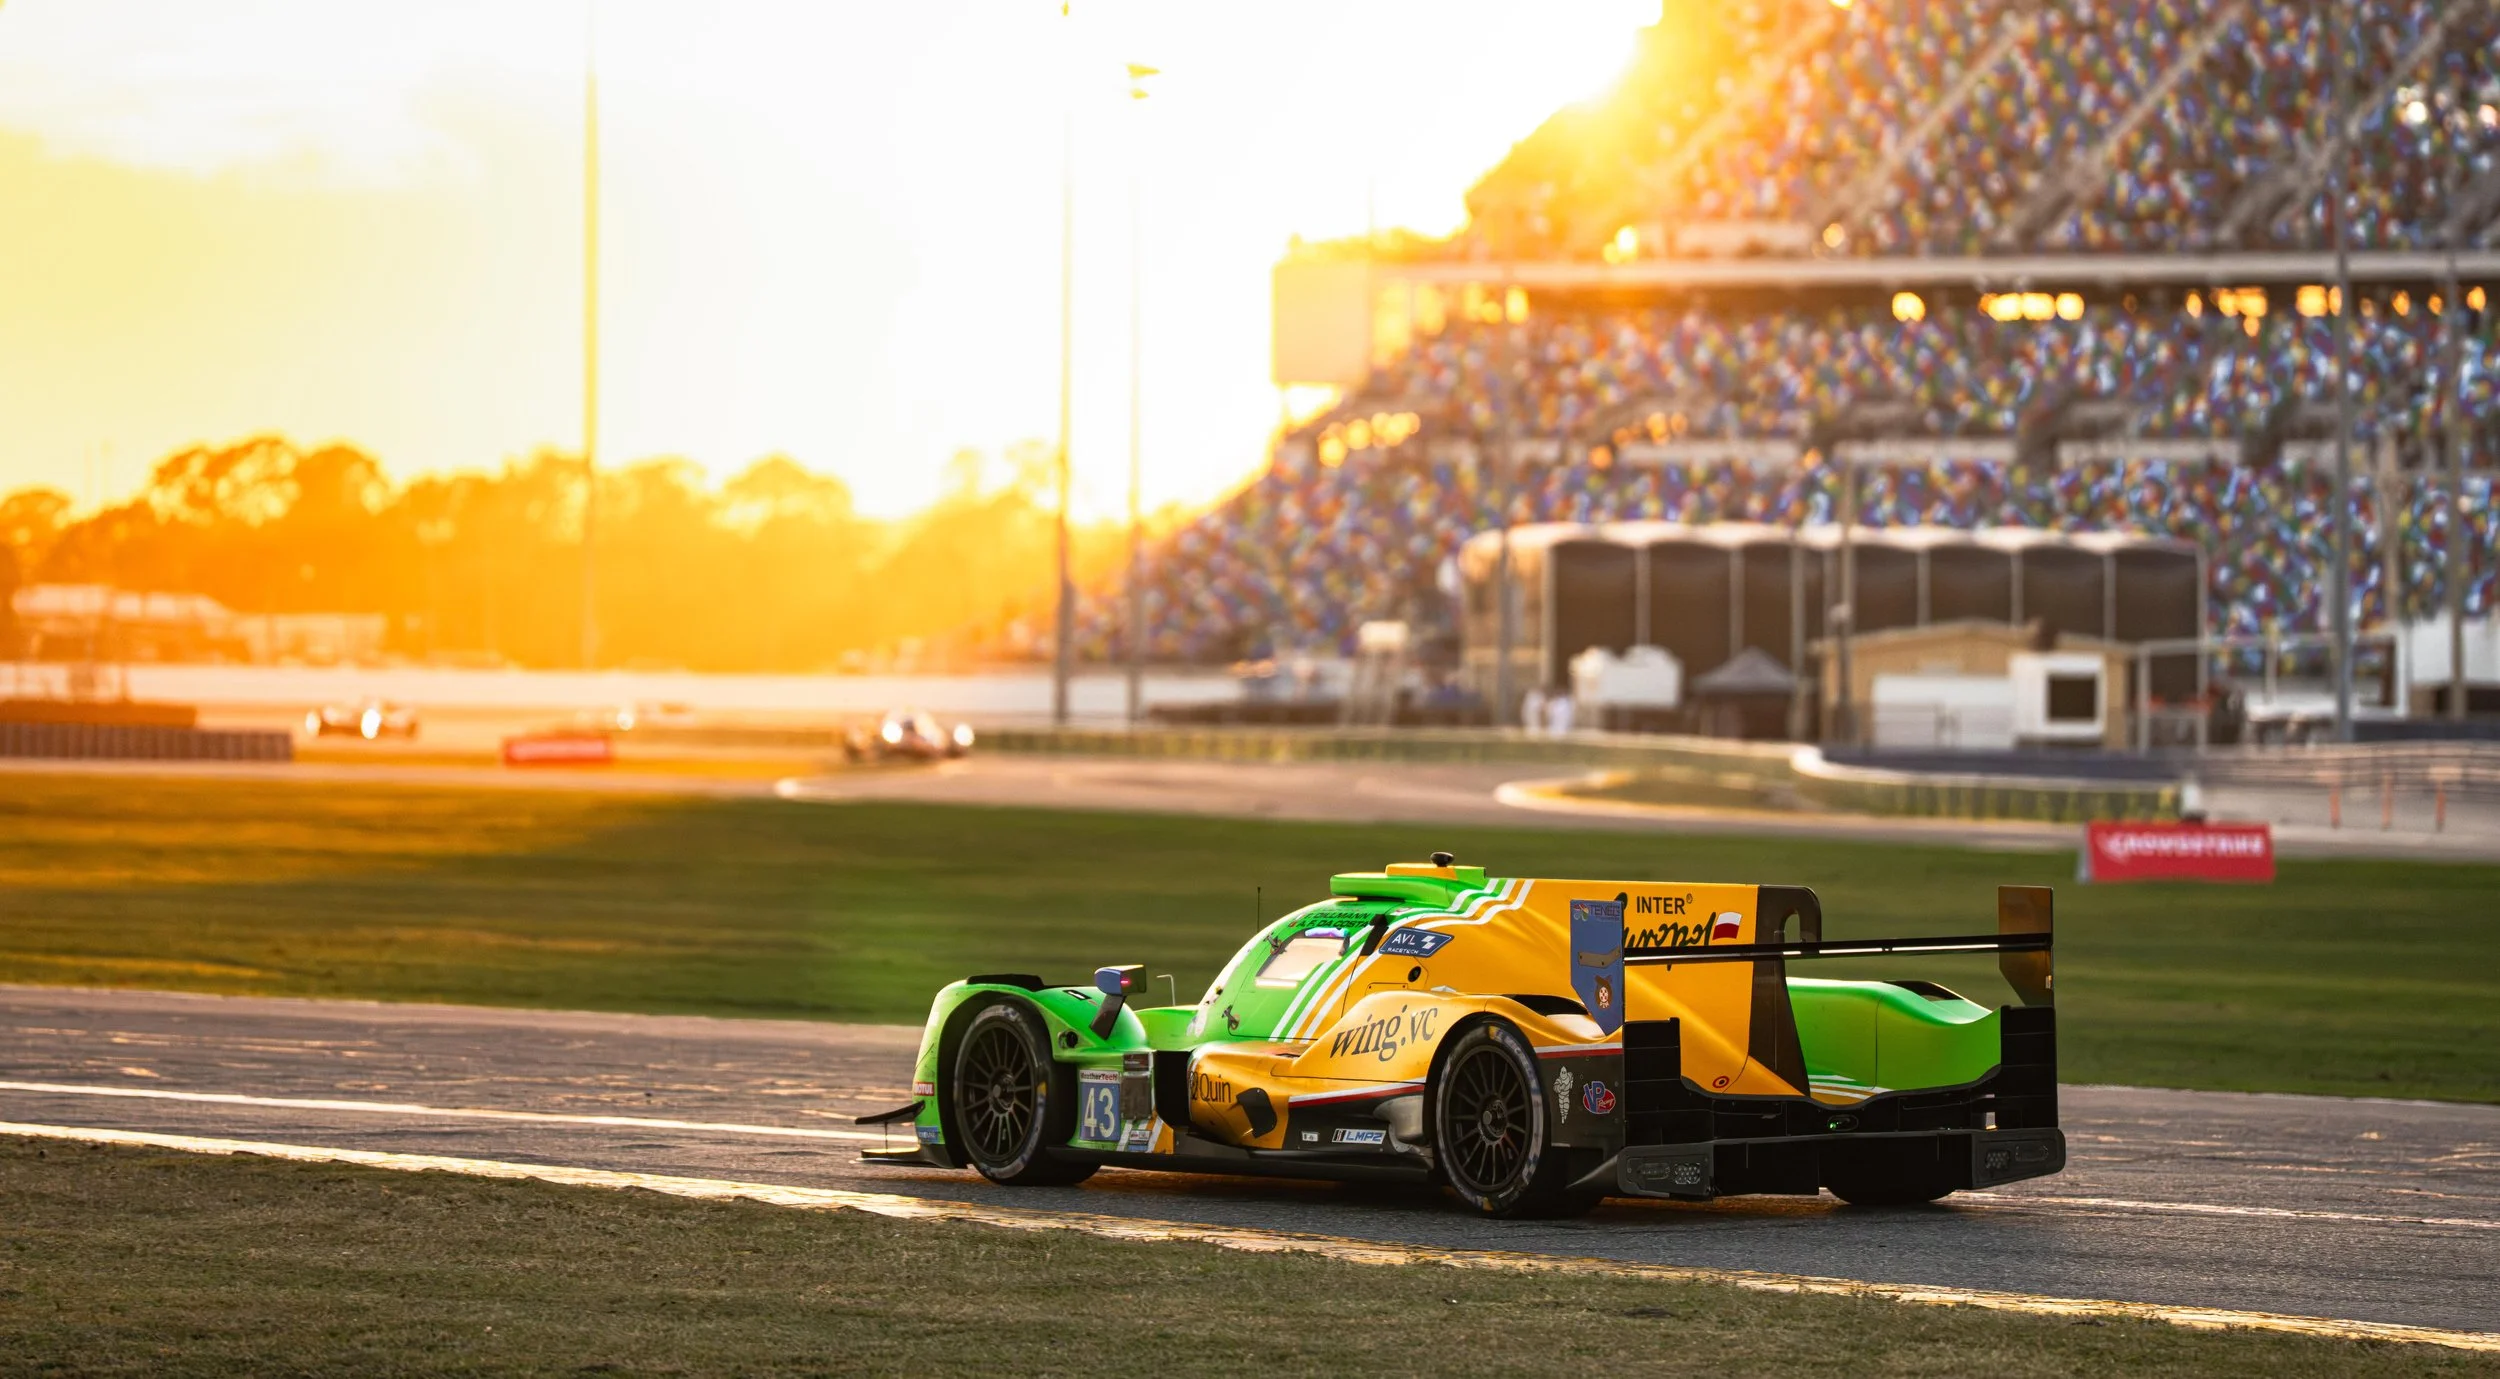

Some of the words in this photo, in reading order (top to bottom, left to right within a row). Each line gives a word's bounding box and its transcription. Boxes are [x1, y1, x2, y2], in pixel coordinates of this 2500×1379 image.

[1636, 895, 1686, 915] INTER
[1391, 933, 1416, 946] AVL
[1084, 1087, 1115, 1138] 43
[1346, 1131, 1382, 1141] LMP2
